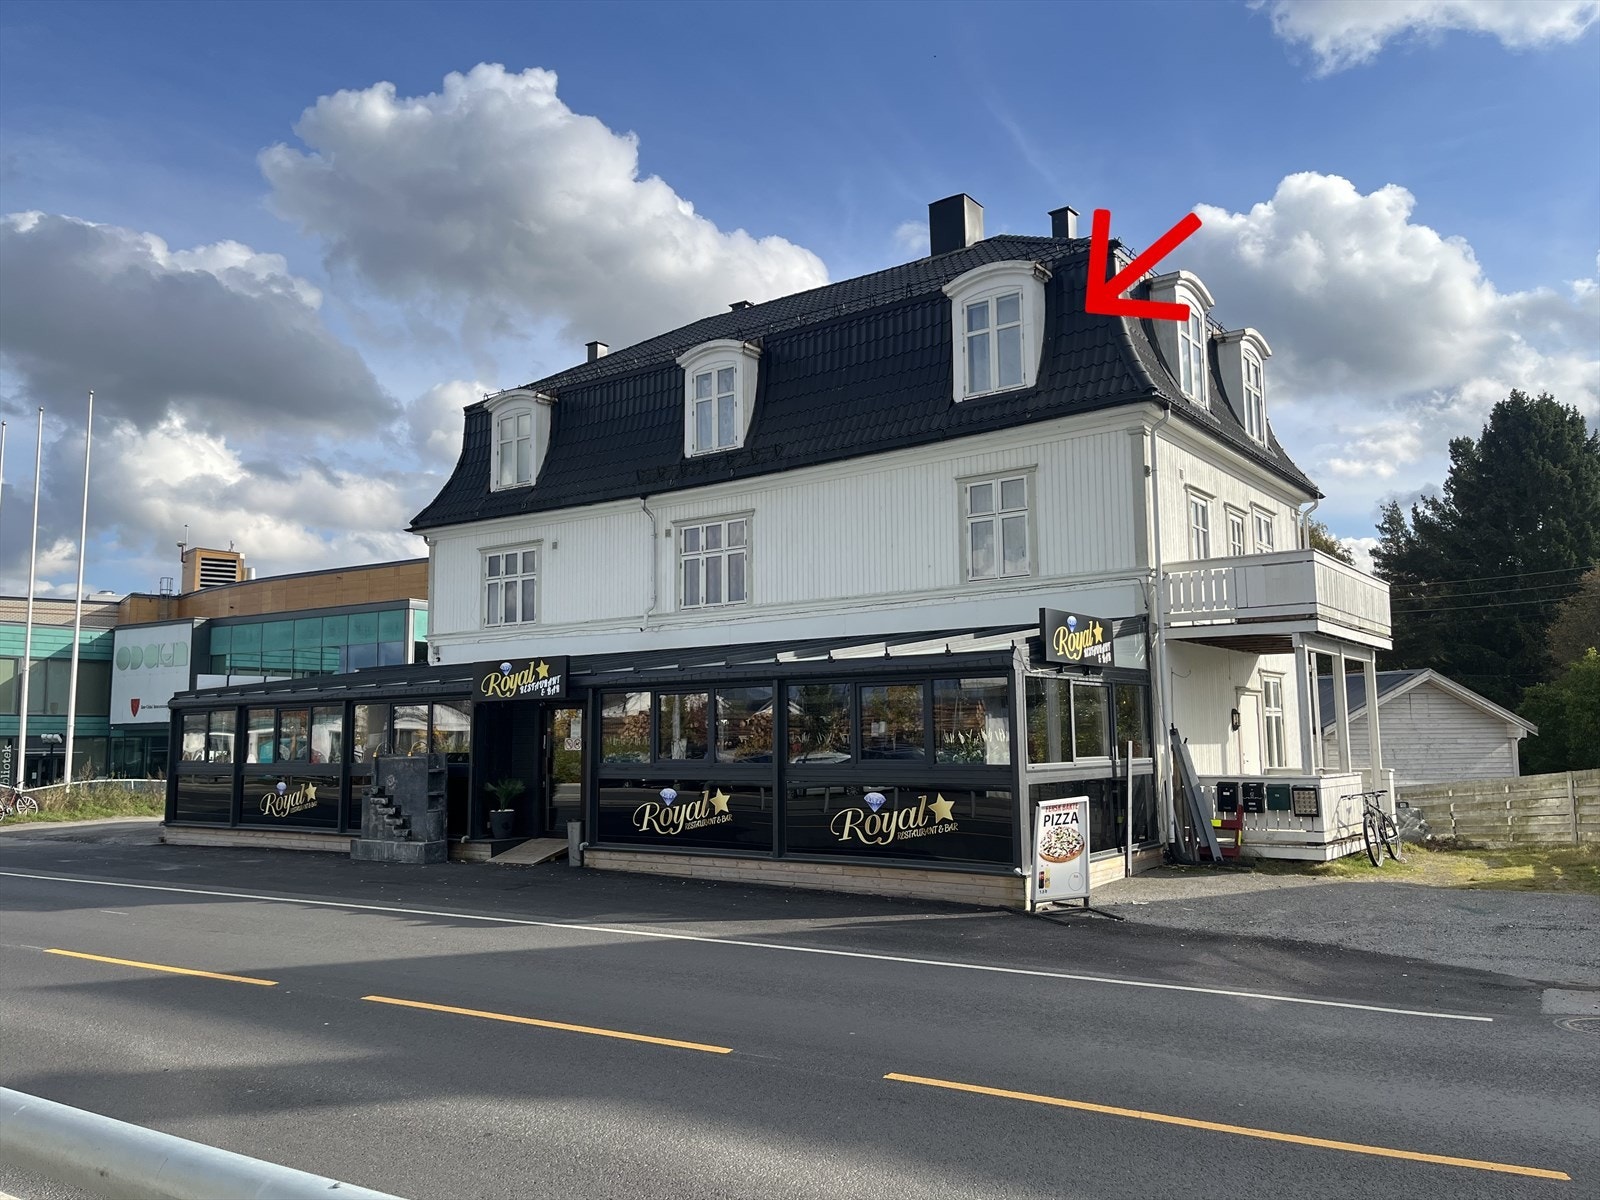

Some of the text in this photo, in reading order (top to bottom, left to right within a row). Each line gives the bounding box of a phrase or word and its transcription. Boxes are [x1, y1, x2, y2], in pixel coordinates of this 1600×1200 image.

[1053, 620, 1094, 661] Royal
[481, 661, 535, 698] Royal
[519, 674, 562, 695] RESTAURANT
[546, 683, 560, 696] BAR
[260, 783, 306, 818] Royal
[632, 790, 710, 835] Royal
[684, 813, 733, 831] RESTAURANT & BAR
[830, 795, 928, 845] Royal
[897, 822, 959, 841] RESTAURANT & BAR
[1043, 811, 1079, 827] PIZZA
